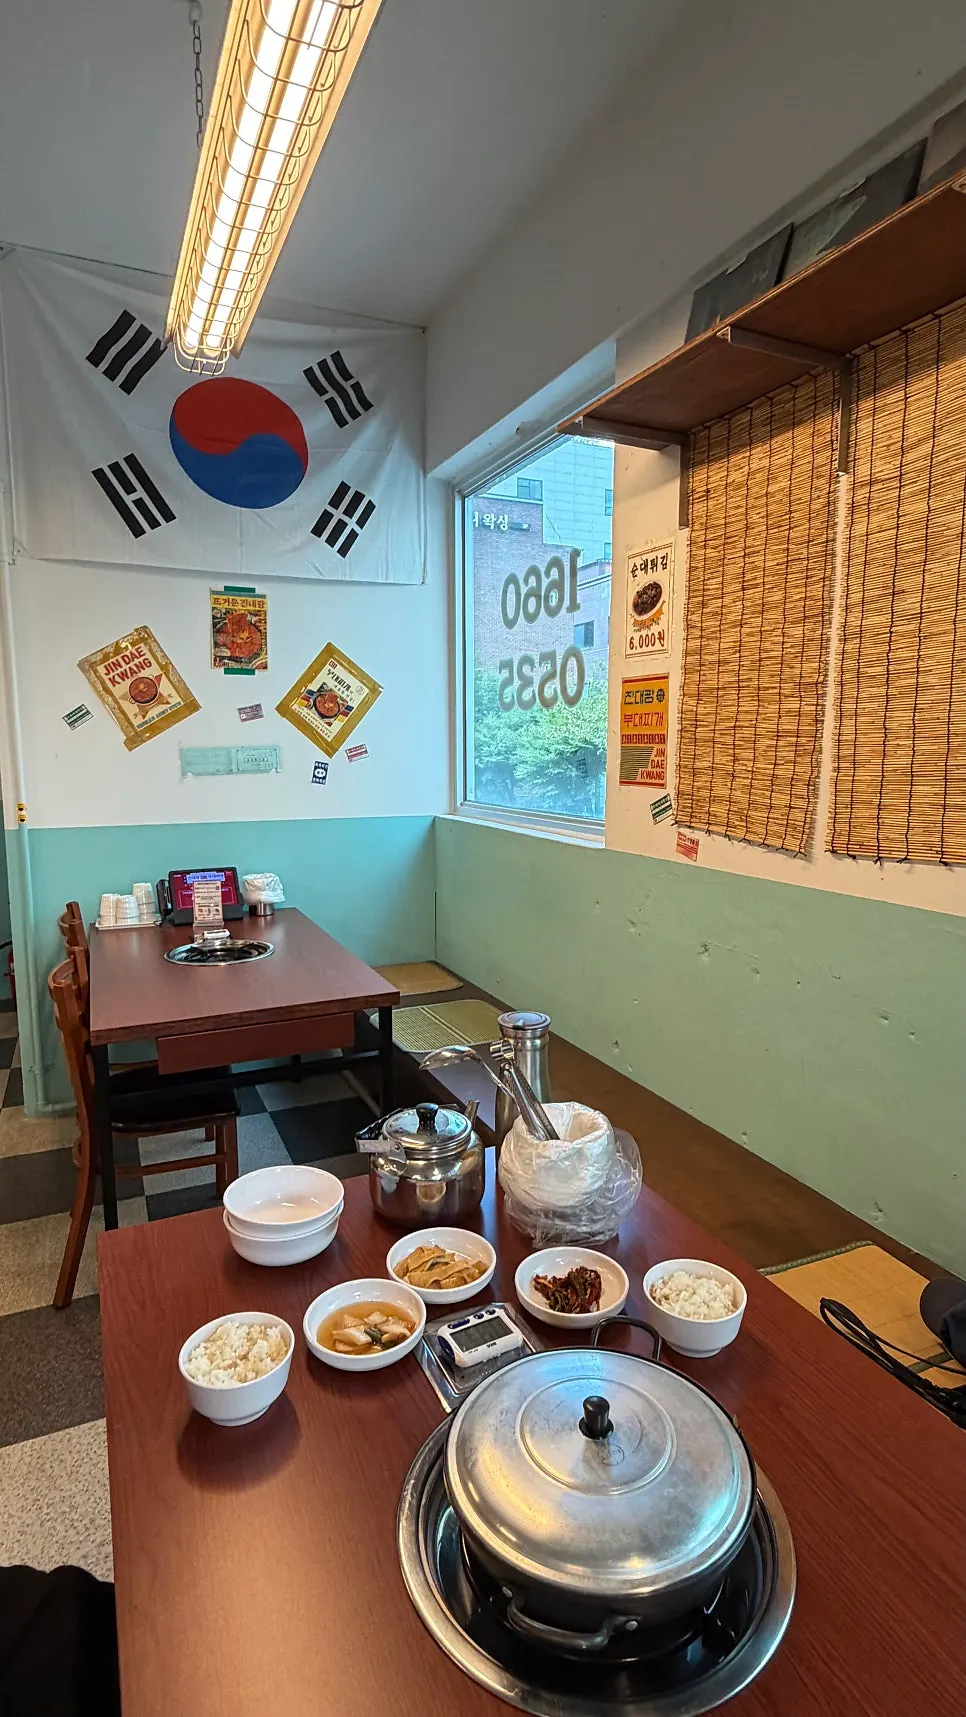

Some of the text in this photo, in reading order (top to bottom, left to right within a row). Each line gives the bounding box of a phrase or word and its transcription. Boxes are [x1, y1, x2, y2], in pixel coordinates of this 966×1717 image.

[482, 513, 508, 531] 왁싱
[630, 552, 669, 578] 순대튀김
[103, 646, 146, 676] JIN DAE
[108, 658, 153, 688] KWANG
[624, 689, 654, 705] 진대광
[623, 712, 664, 728] 부대찌개
[654, 747, 666, 758] JIN
[651, 759, 665, 769] DAE
[640, 769, 665, 781] KWANG
